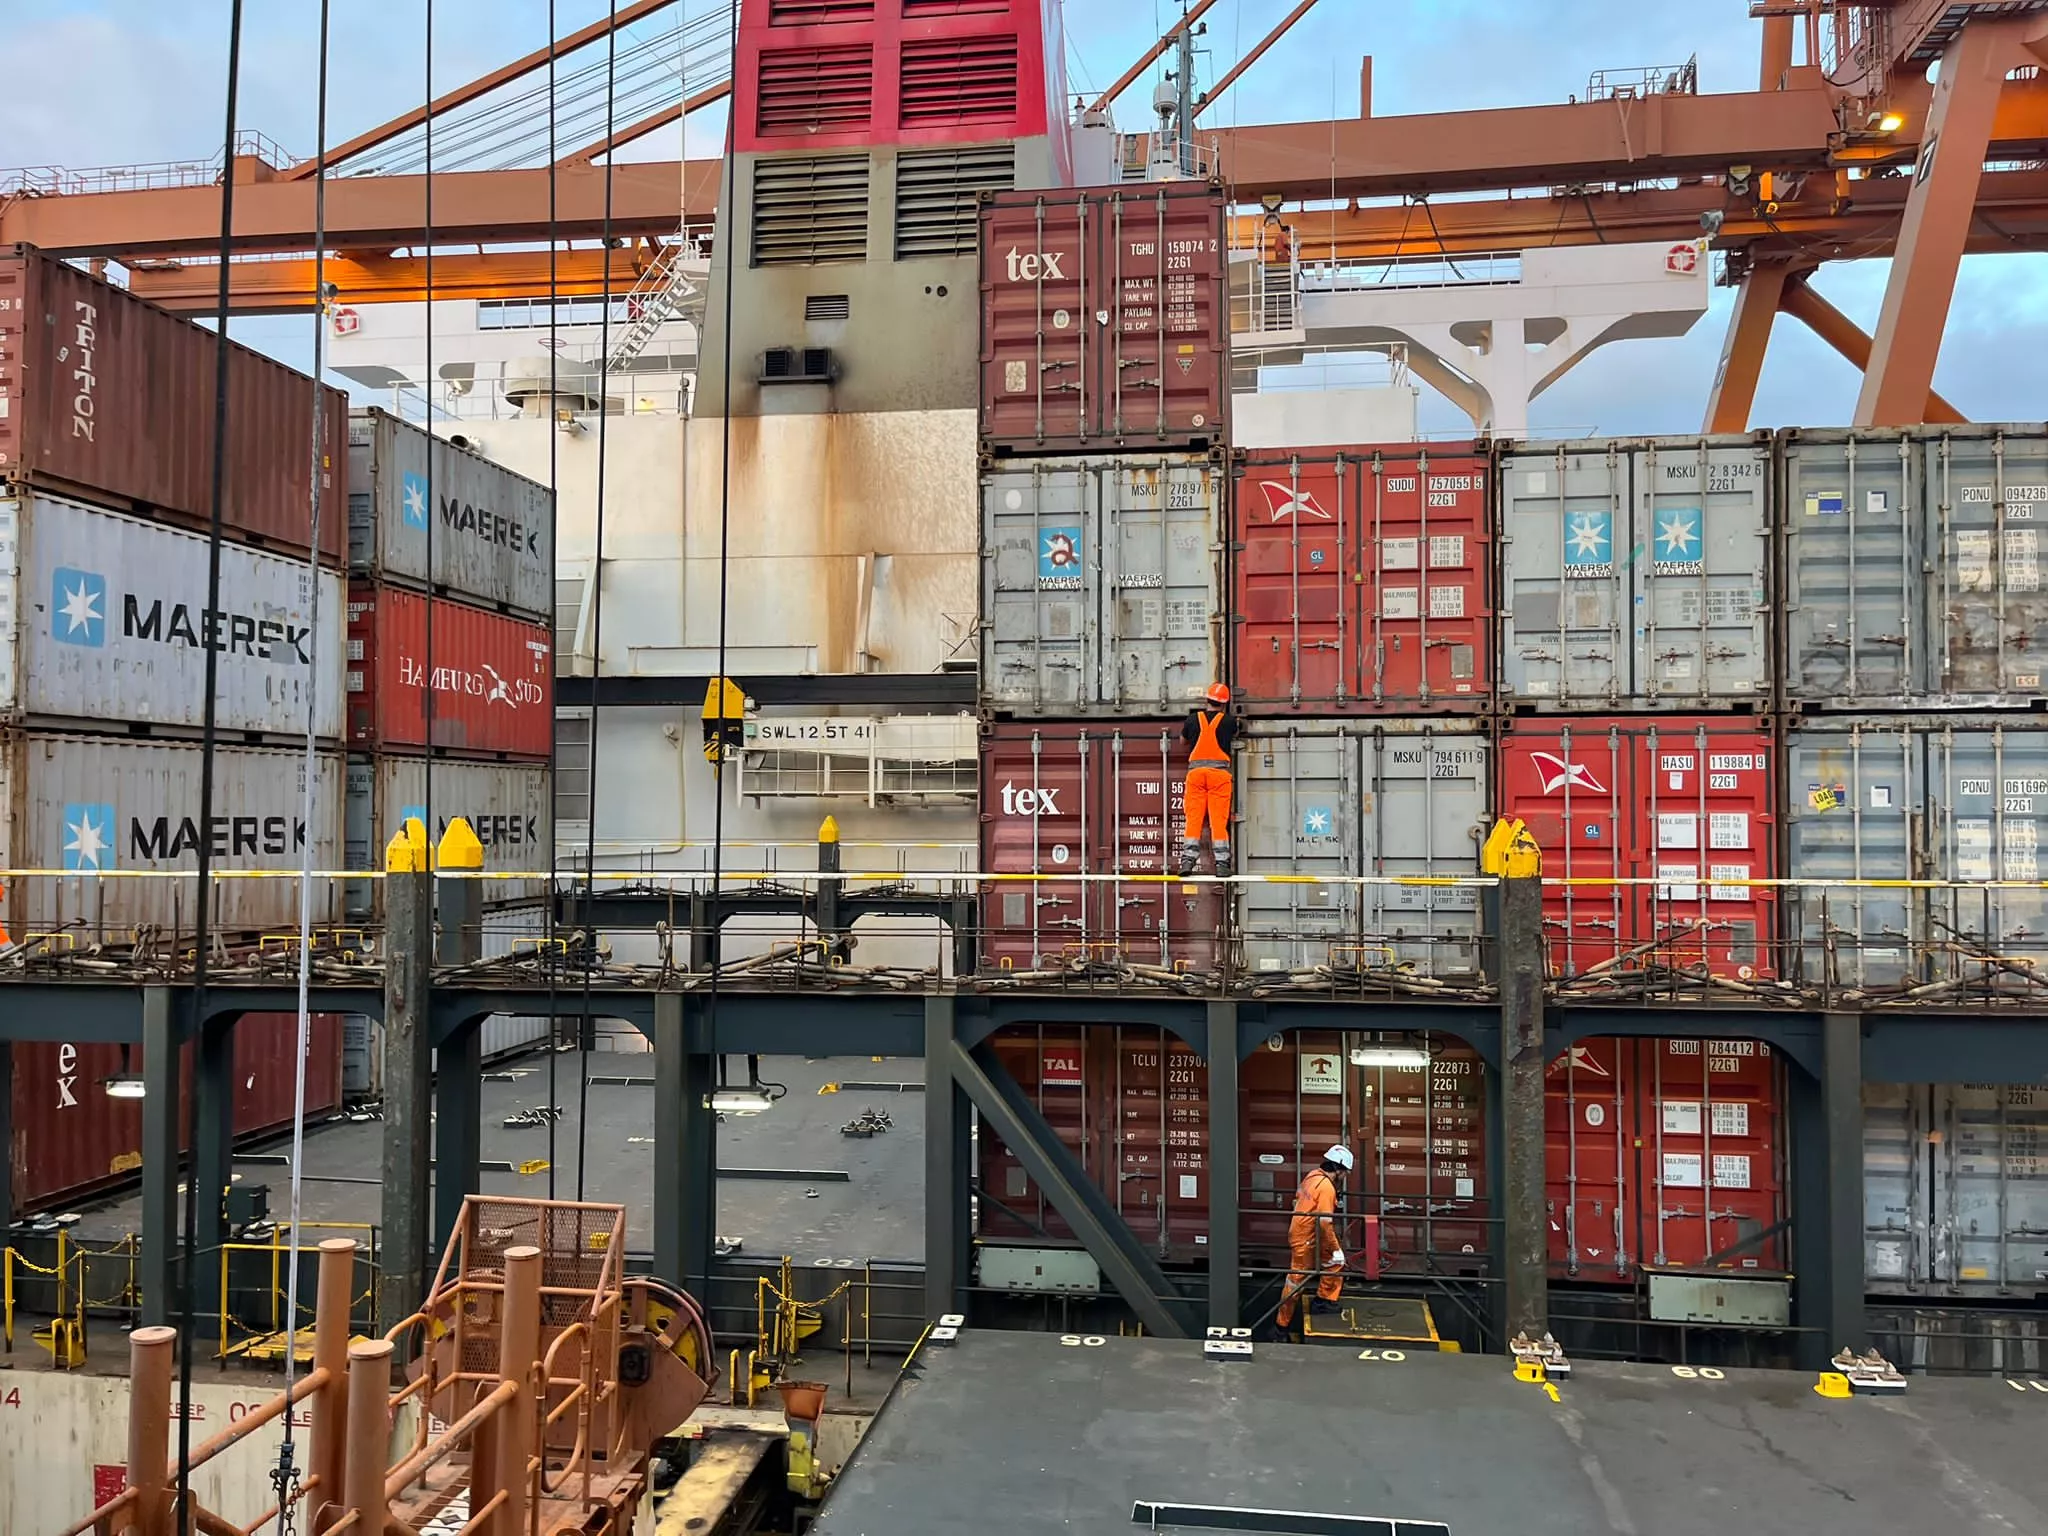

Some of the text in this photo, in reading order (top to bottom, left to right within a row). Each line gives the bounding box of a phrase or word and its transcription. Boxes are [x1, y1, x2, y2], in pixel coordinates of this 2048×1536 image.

[1130, 239, 1217, 256] TGHU 159074 2
[1168, 256, 1191, 268] 22G1
[1124, 308, 1152, 317] PAYLOAD
[72, 300, 97, 442] TRITON
[1667, 466, 1696, 479] MSKU
[1388, 477, 1482, 491] SUDU 757055 5
[1710, 478, 1735, 491] 22G1
[1131, 485, 1158, 496] MSKU
[1962, 487, 2046, 501] PONU 094236
[1170, 496, 1193, 507] 22G1
[1429, 494, 1456, 506] 22G1
[2007, 505, 2033, 517] 22G1
[439, 493, 539, 559] MAERSK
[1311, 551, 1323, 559] GL
[1564, 564, 1612, 572] MAERSK
[1039, 576, 1082, 584] MAERSK
[1119, 574, 1162, 582] MAERSK
[123, 593, 310, 664] MAERSK
[1393, 752, 1422, 763] MSKU
[1662, 755, 1764, 769] HASU 119884 9
[1435, 765, 1459, 777] 22G1
[1711, 774, 1737, 788] 22G1
[1961, 780, 2045, 794] PONU 061696
[1136, 783, 1160, 794] TEMU
[1171, 798, 1185, 809] 22
[2006, 799, 2032, 812] 22G1
[1129, 816, 1160, 825] MAX. WT.
[1147, 831, 1160, 839] WT.
[1585, 825, 1599, 834] GL
[1129, 845, 1156, 854] PAYLOAD
[1670, 1041, 1700, 1054] SUDU
[1710, 1042, 1753, 1055] 784412
[1044, 1059, 1079, 1071] TAL
[1132, 1054, 1207, 1068] TCLU 23790
[1710, 1059, 1739, 1072] 22G1
[1433, 1062, 1471, 1074] 222873
[1170, 1070, 1194, 1083] 22G1
[1433, 1079, 1457, 1091] 22G1
[2008, 1093, 2033, 1105] 22G1
[0, 1387, 22, 1410] 4
